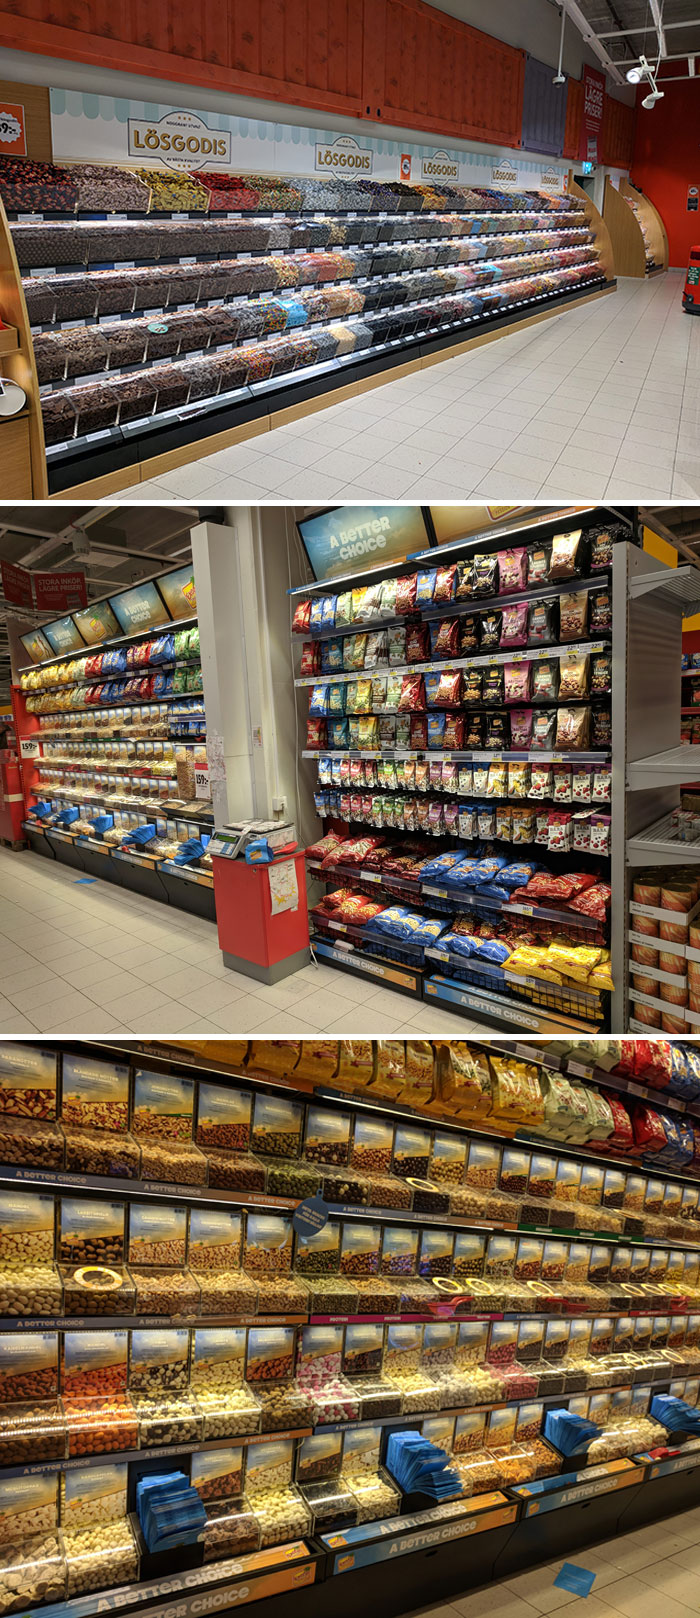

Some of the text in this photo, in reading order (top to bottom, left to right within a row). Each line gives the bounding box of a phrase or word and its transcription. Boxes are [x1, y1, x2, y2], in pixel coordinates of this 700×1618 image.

[134, 128, 227, 156] LÖSGODIS
[318, 149, 370, 169] LÖSGODIS
[423, 162, 457, 177] LÖSGODIS
[330, 516, 391, 560] A BETTER CHOICE
[124, 600, 151, 624] A BETTER CHOICE
[338, 952, 360, 966] BETTER
[360, 961, 384, 975] CHOICE
[461, 996, 539, 1028] A BETTER CHOICE
[144, 1047, 170, 1059] BETTER
[171, 1052, 195, 1063] CHOICE
[24, 1172, 56, 1181] BETTER
[57, 1175, 87, 1184] CHOICE
[151, 1185, 176, 1193] BETTER
[177, 1187, 201, 1195] CHOICE
[253, 1196, 275, 1204] BETTER
[276, 1198, 295, 1206] CHOICE
[150, 1448, 176, 1457] BETTER
[176, 1445, 200, 1453] CHOICE
[31, 1464, 61, 1473] BETTER
[62, 1460, 90, 1469] CHOICE
[561, 1479, 618, 1503] A BETTER CHOICE
[380, 1504, 467, 1535] A BETTER CHOICE
[389, 1521, 477, 1554] A BETTER CHOICE
[96, 1563, 244, 1613] A BETTER CHOICE
[190, 1587, 250, 1613] CHOICE
